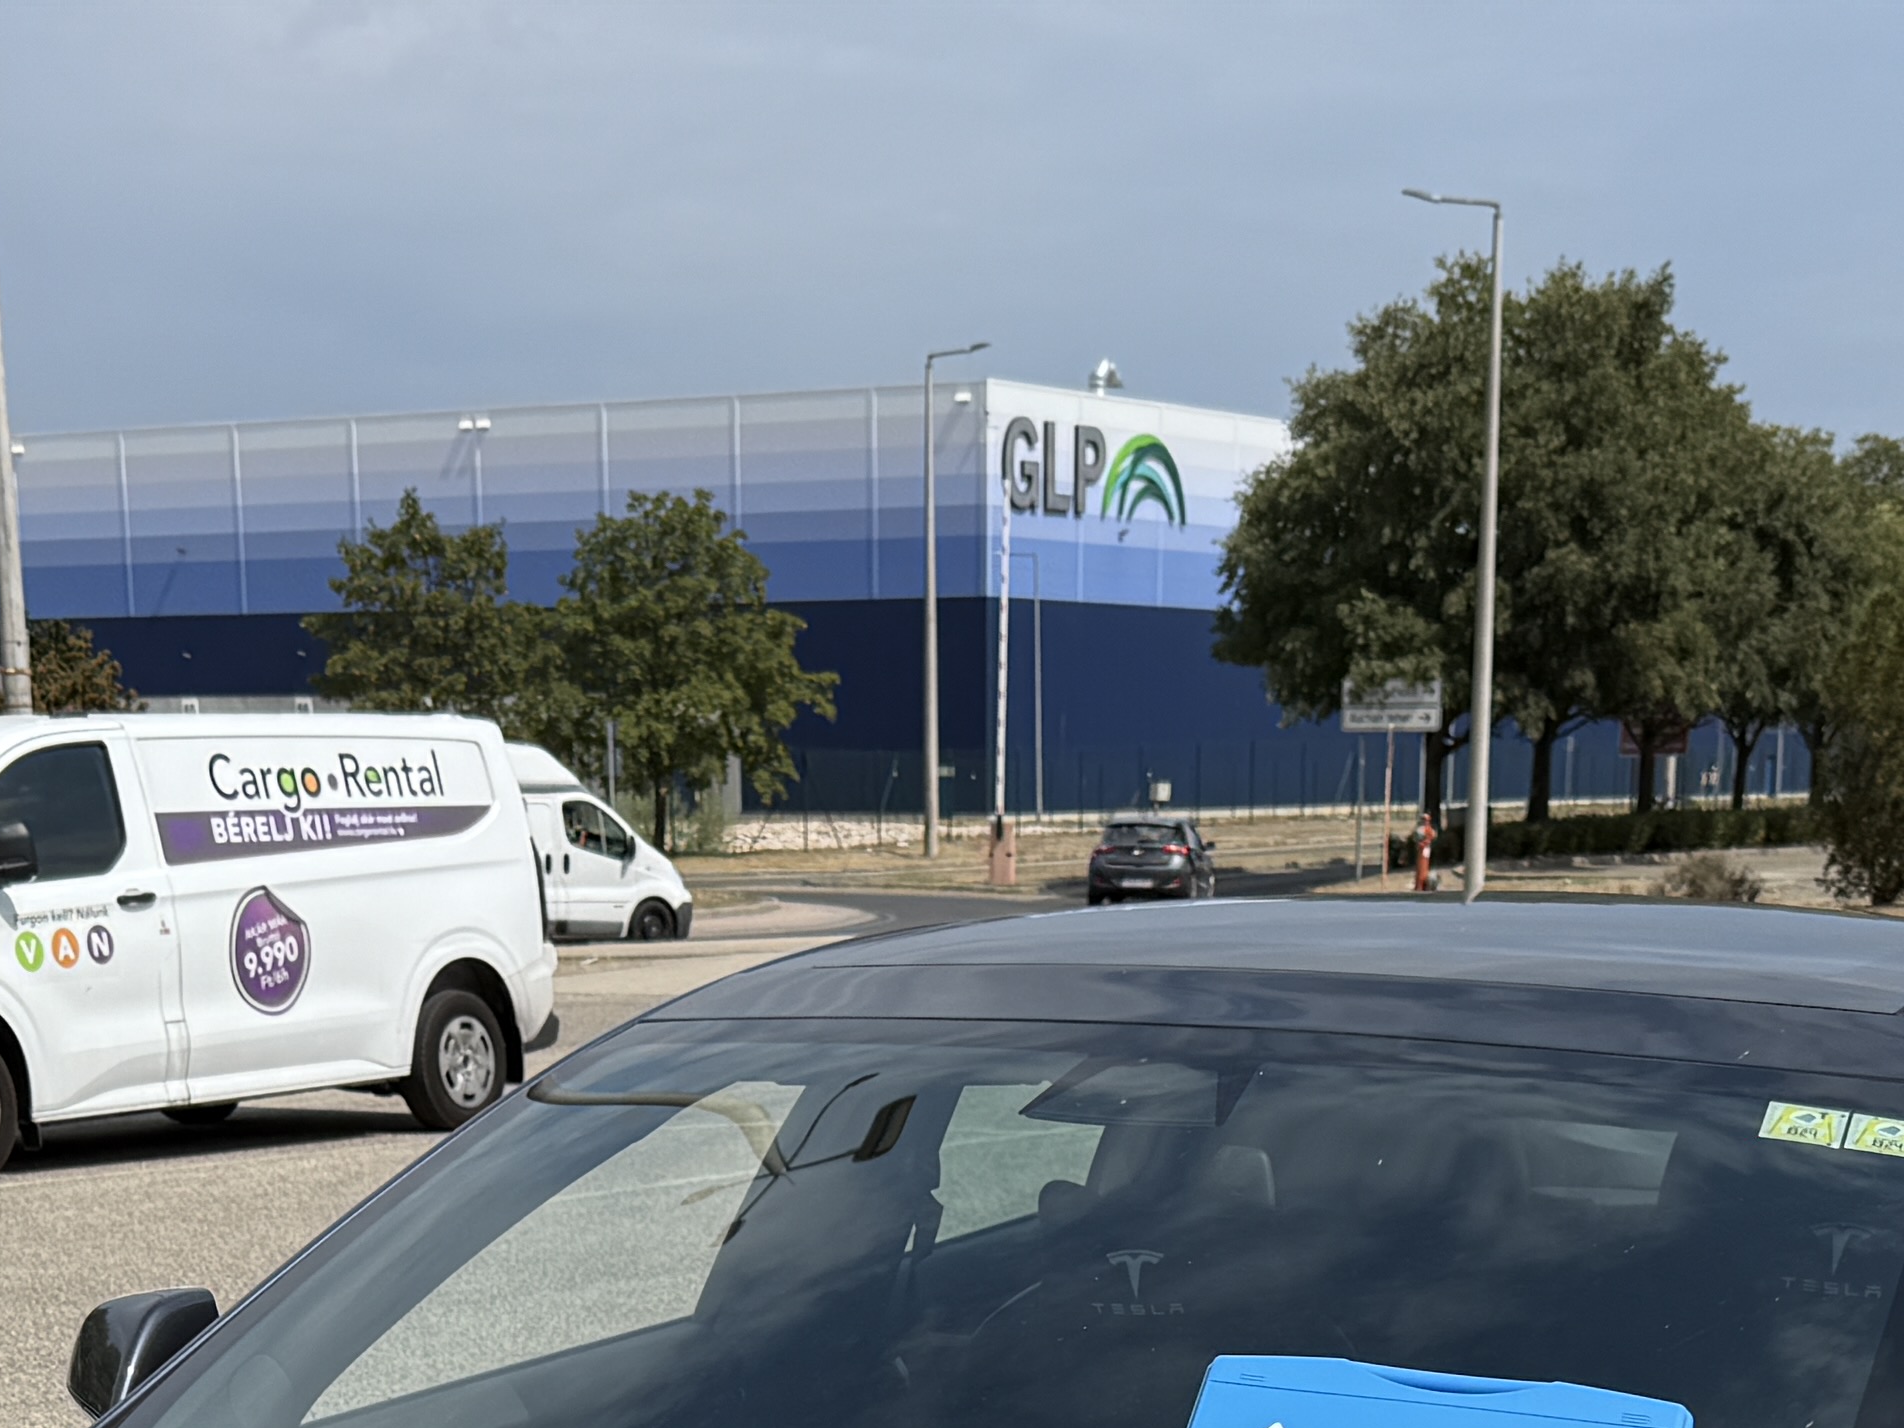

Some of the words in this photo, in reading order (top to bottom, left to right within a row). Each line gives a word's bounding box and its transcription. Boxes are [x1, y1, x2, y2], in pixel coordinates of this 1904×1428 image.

[1001, 416, 1107, 520] GLP
[208, 752, 321, 813] Cargo
[338, 748, 445, 797] Rental
[210, 811, 295, 844] BÉRELJ
[299, 812, 333, 843] KI!
[243, 934, 299, 979] 9.990
[1779, 1275, 1882, 1299] TESLA
[1090, 1303, 1185, 1316] TESLA
